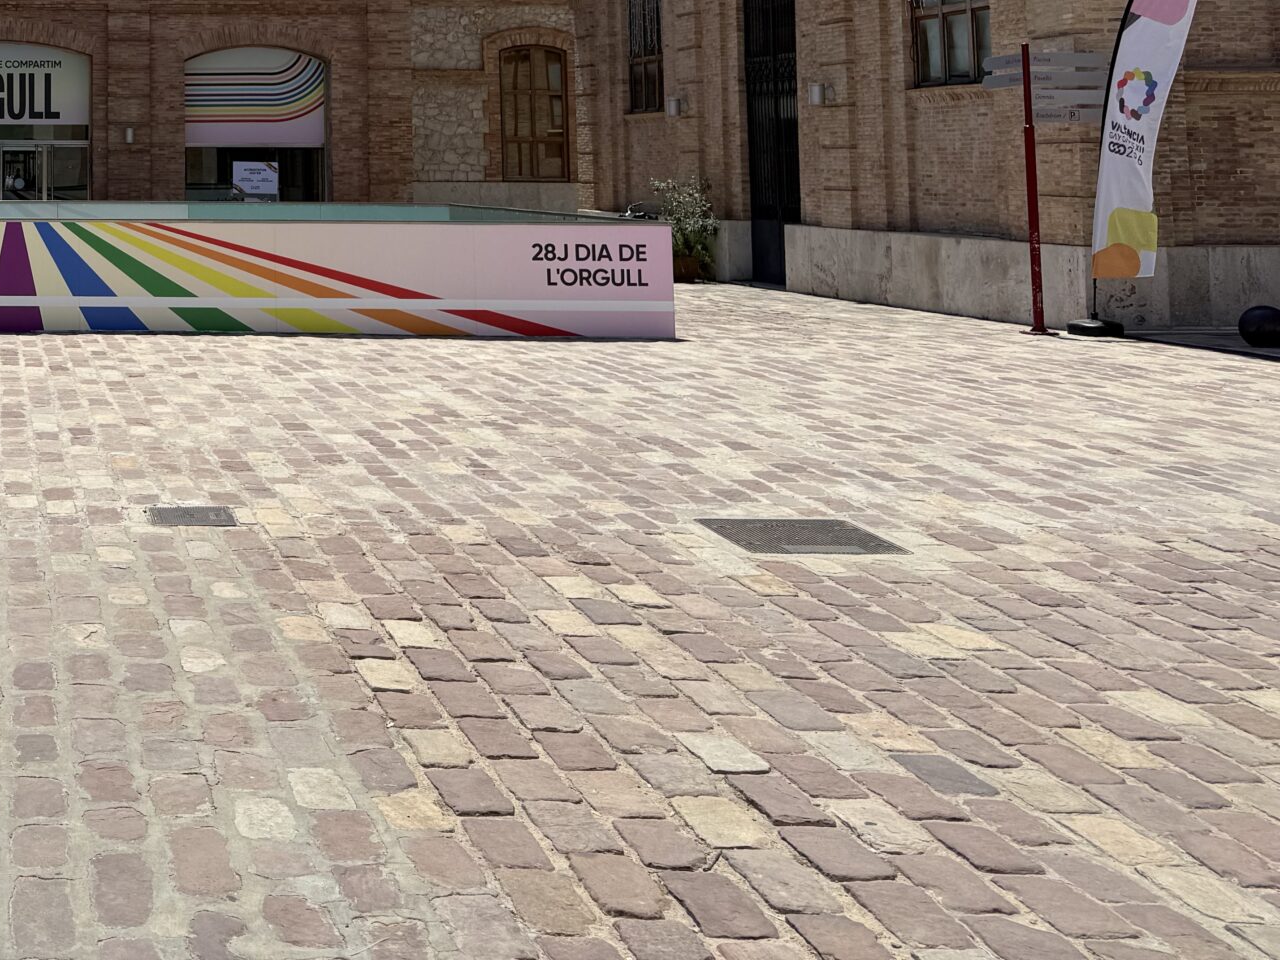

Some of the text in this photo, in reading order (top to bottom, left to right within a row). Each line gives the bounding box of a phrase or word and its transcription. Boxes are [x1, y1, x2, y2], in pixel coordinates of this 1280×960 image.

[4, 60, 62, 69] COMPARTIM
[531, 243, 647, 261] 28J DIA DE
[546, 268, 649, 287] L'ORGULL
